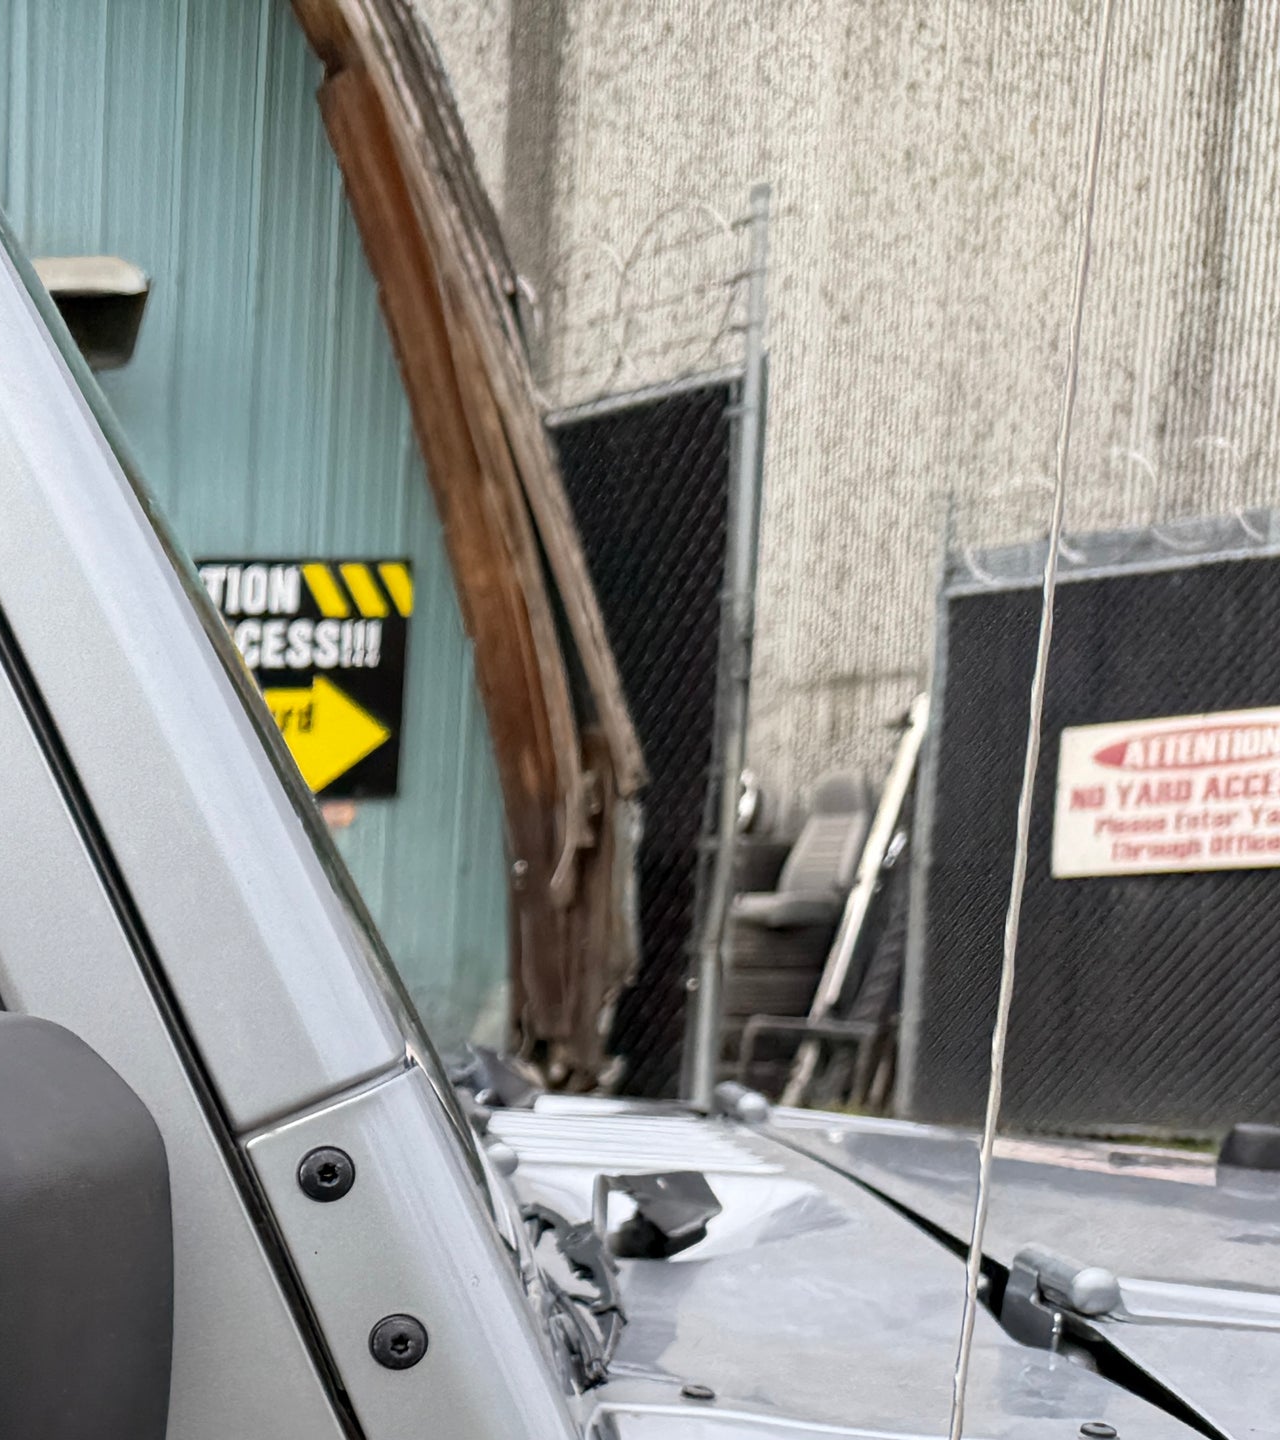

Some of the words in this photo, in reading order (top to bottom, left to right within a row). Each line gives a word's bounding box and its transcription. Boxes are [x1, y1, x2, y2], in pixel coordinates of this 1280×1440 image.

[199, 563, 301, 615] TION
[272, 702, 313, 733] rd
[1070, 785, 1105, 811] NO
[1117, 779, 1192, 806] YARD
[1202, 771, 1280, 801] ACCE
